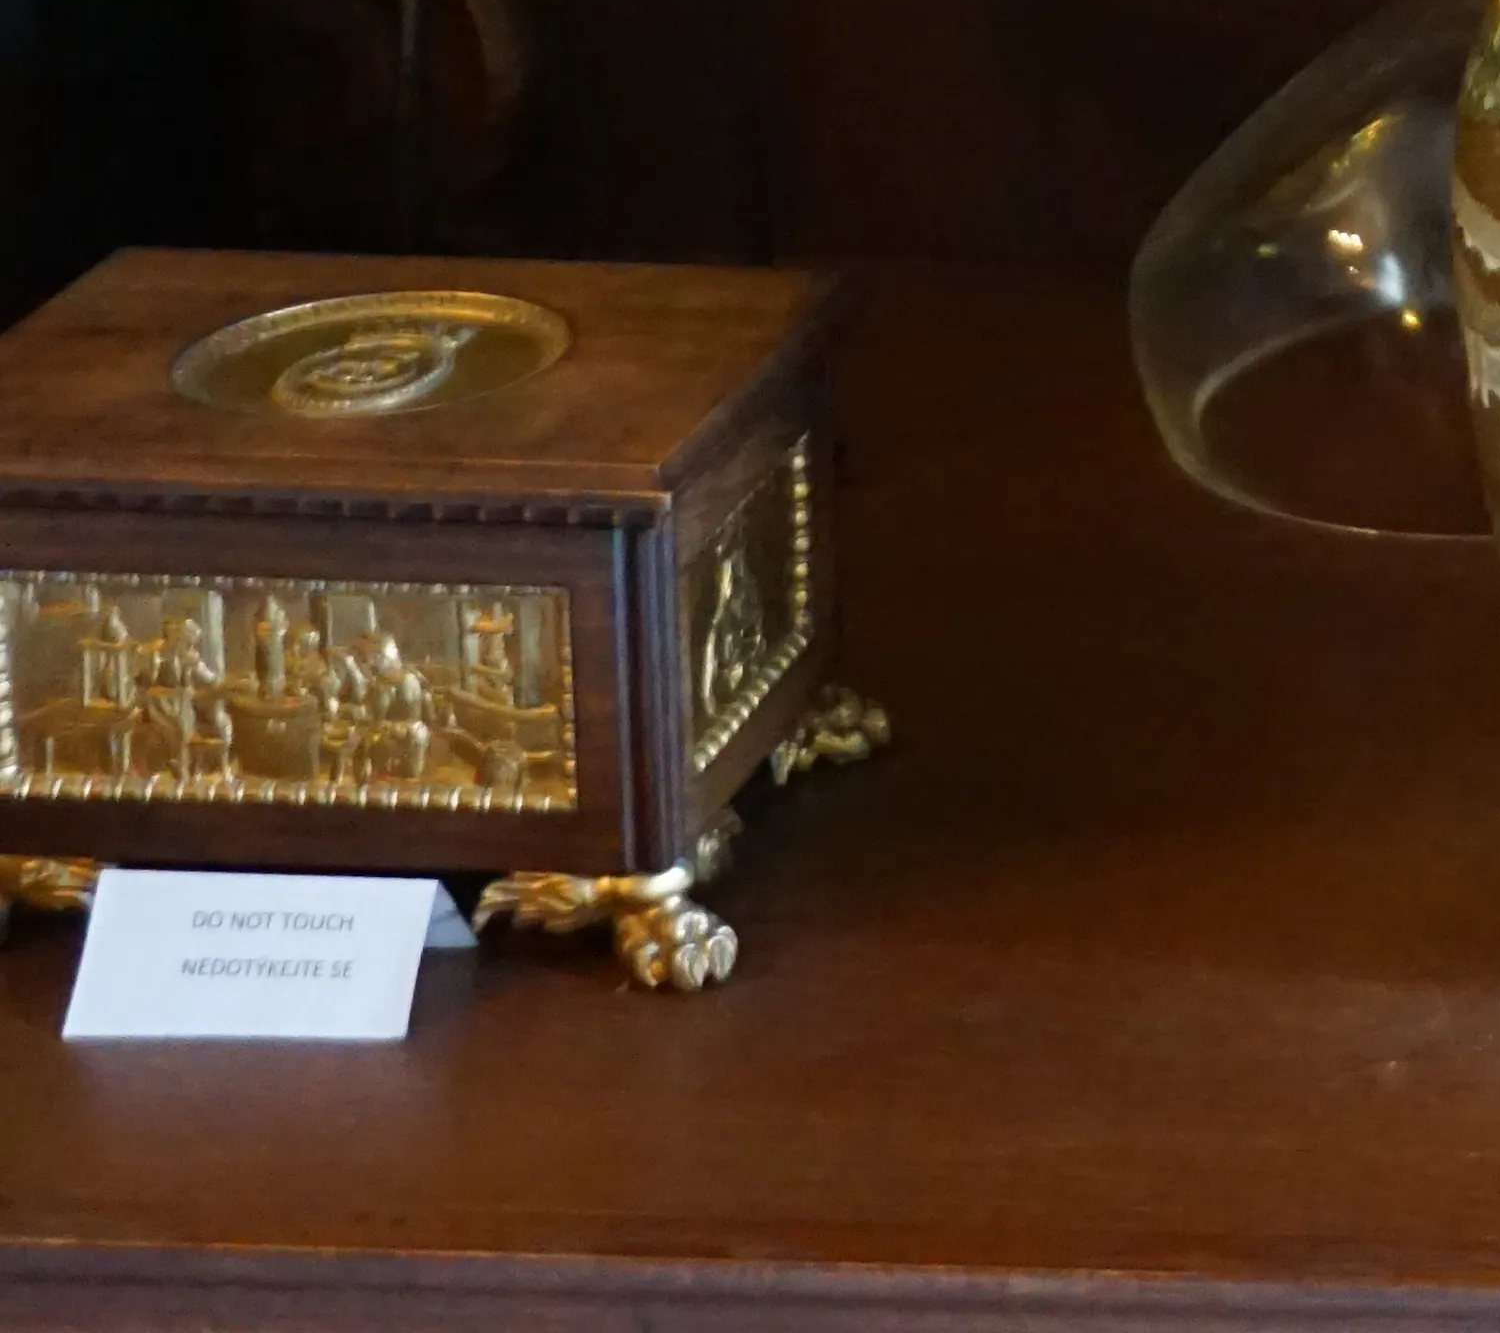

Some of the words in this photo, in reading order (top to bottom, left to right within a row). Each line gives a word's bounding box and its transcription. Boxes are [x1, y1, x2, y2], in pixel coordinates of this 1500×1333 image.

[192, 909, 224, 930] DO
[229, 910, 272, 932] NOT
[281, 911, 355, 933] TOUCH
[329, 958, 355, 979] SE
